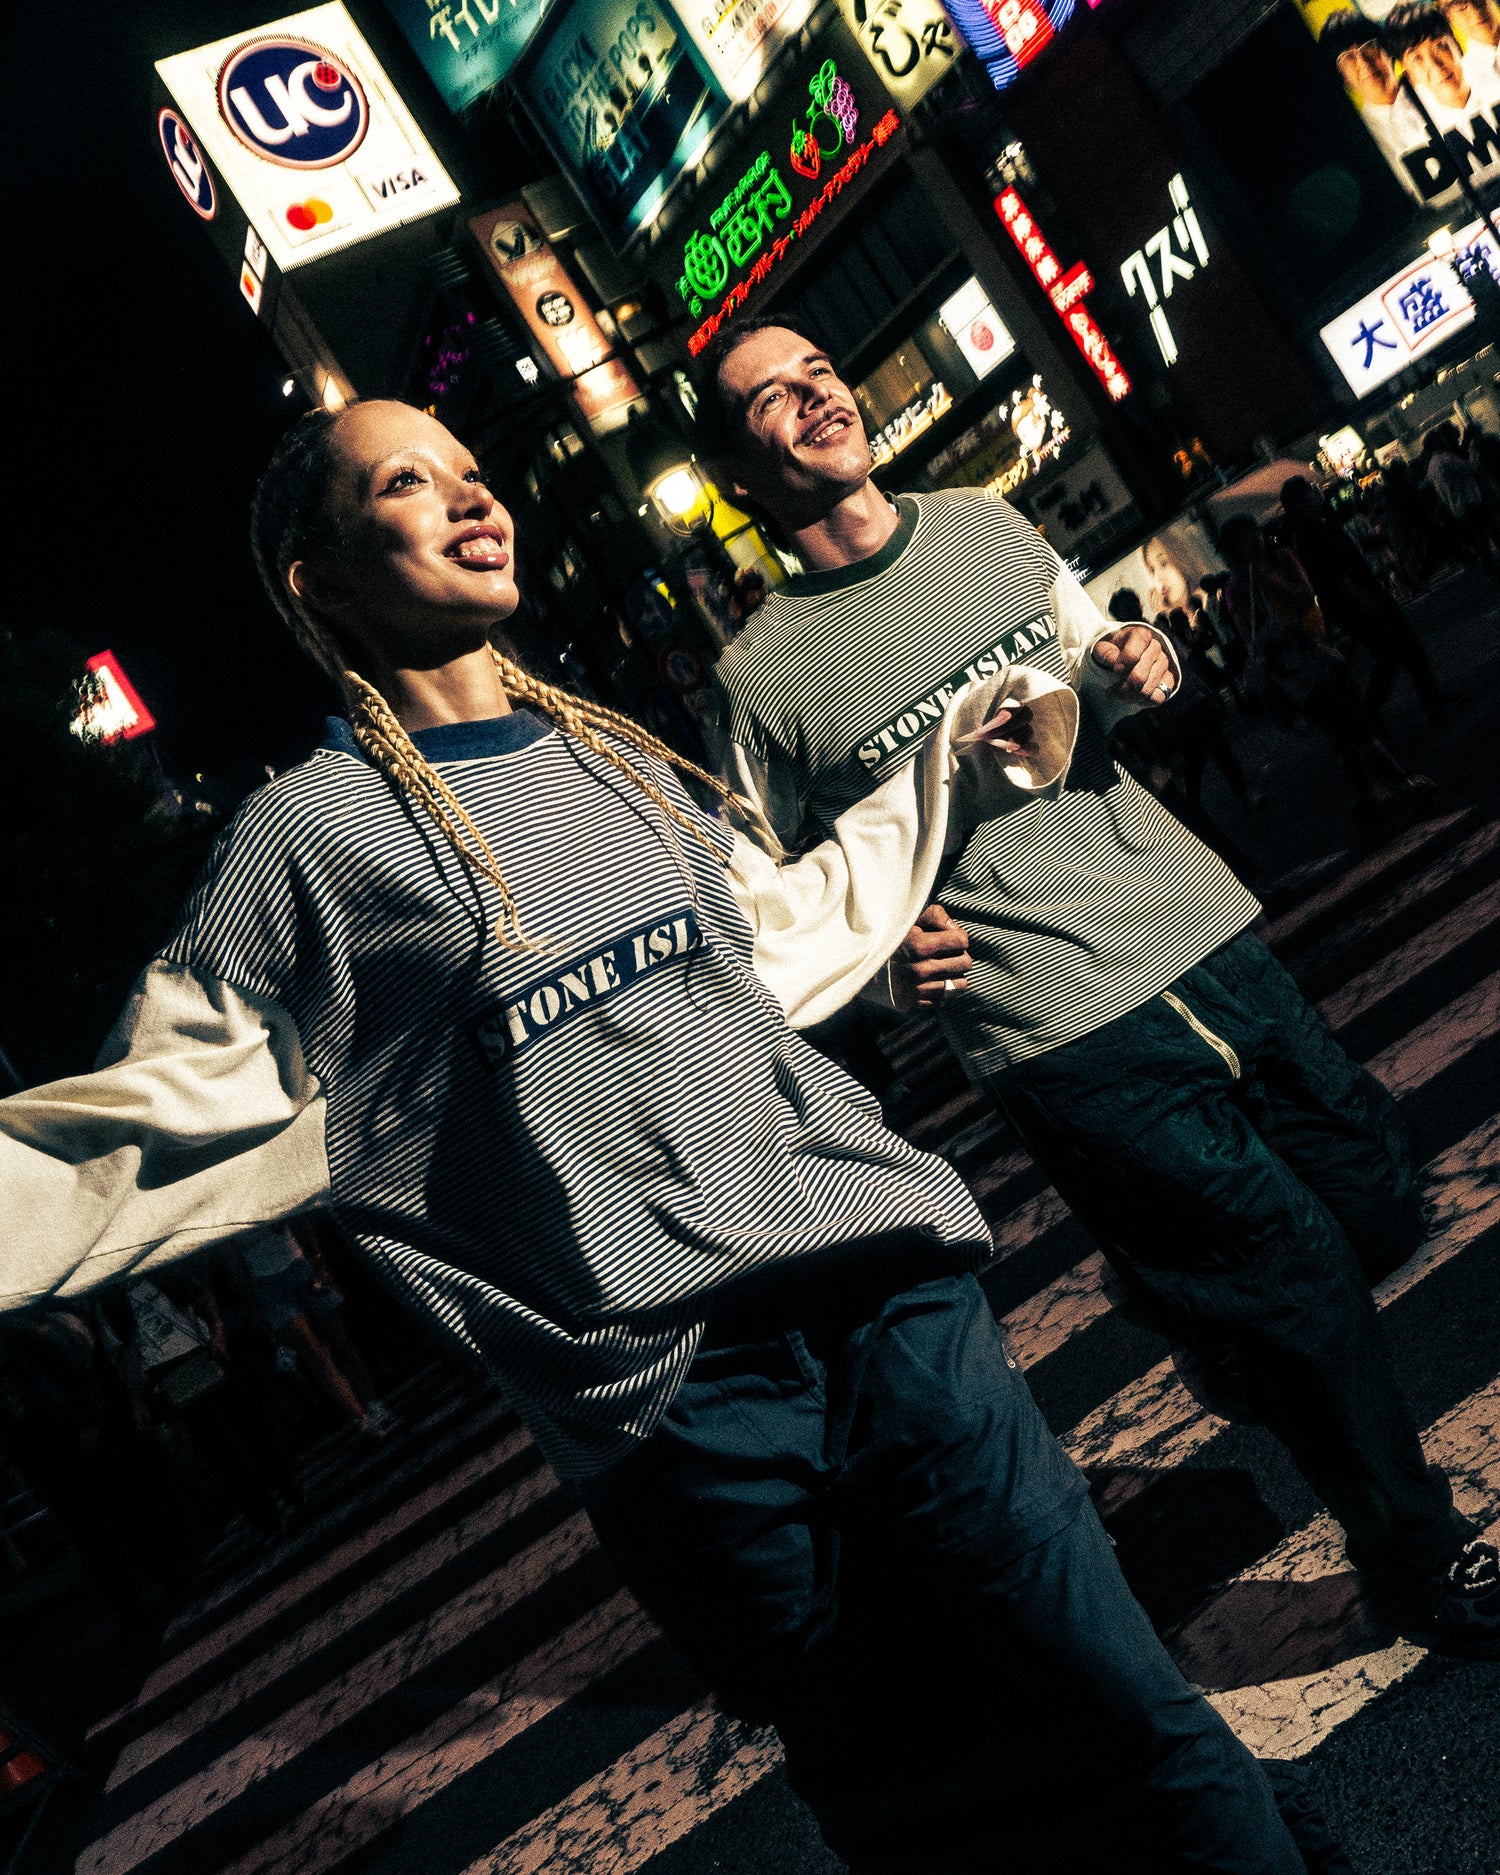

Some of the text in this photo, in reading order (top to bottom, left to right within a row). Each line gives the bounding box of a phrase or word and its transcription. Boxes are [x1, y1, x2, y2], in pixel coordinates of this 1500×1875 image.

[230, 60, 352, 145] UC
[371, 168, 429, 199] VISA
[719, 167, 793, 268] 西村
[1120, 172, 1210, 368] クスリ
[858, 682, 954, 769] STONE
[631, 917, 704, 974] ISL
